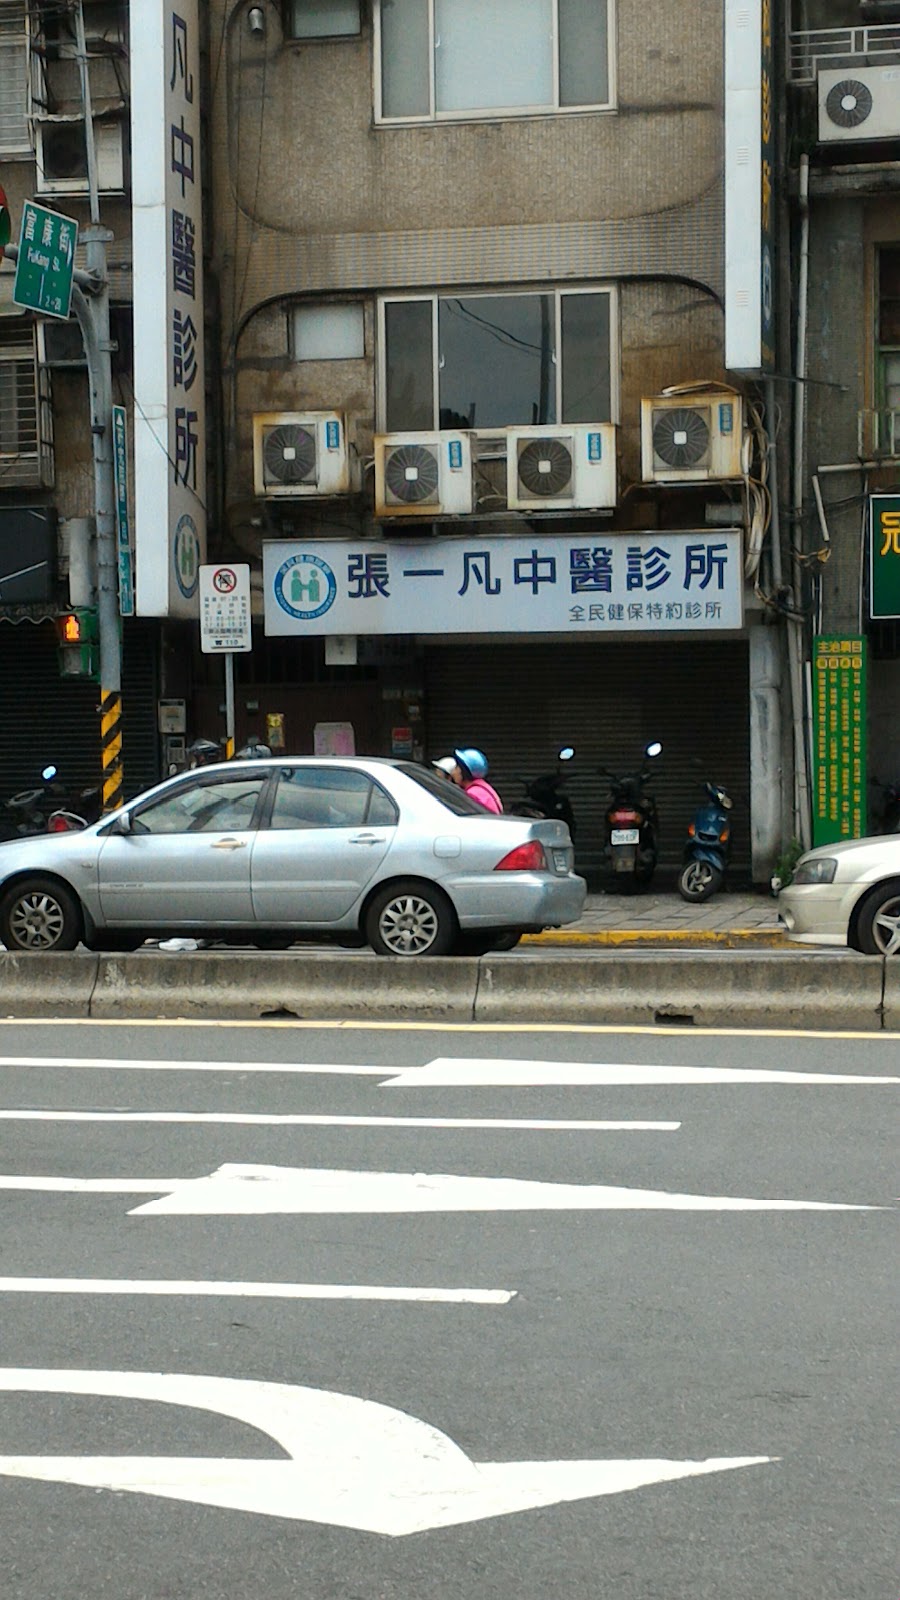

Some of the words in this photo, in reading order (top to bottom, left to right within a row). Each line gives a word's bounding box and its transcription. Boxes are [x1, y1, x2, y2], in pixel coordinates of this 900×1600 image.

[170, 12, 200, 490] 凡中醫診所
[347, 543, 728, 599] 張一凡中醫診所
[568, 601, 722, 622] 全民健保特約診所
[817, 640, 863, 653] 主治項目
